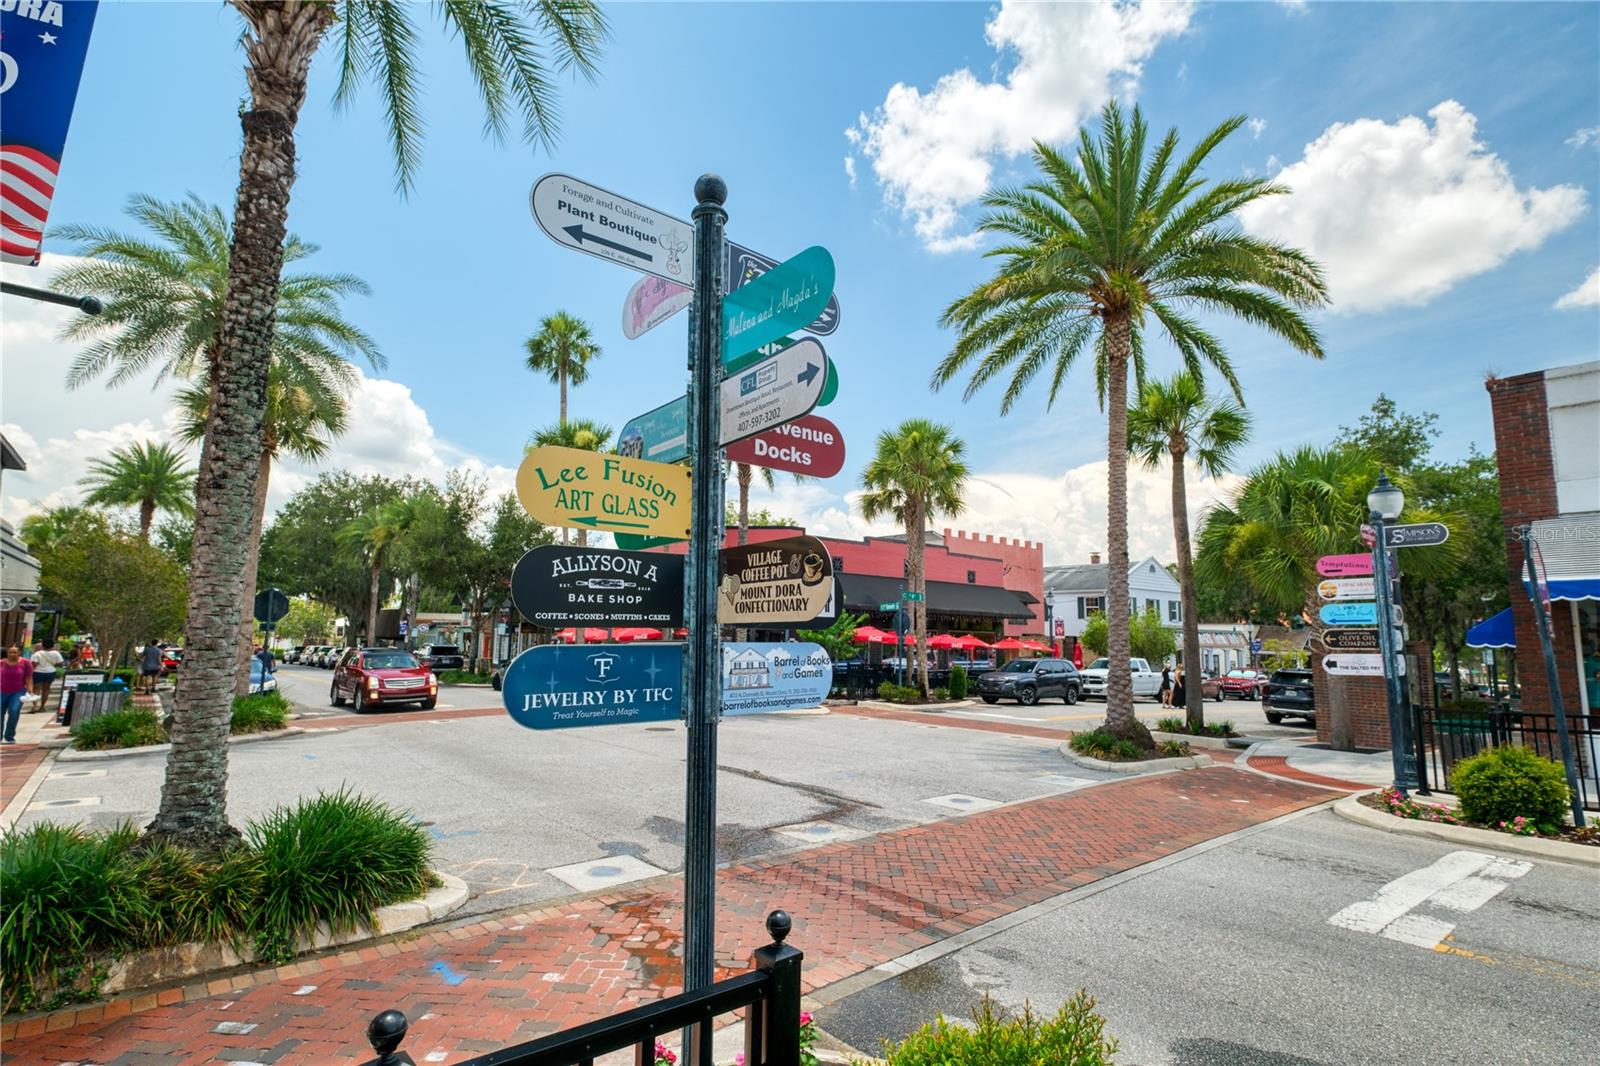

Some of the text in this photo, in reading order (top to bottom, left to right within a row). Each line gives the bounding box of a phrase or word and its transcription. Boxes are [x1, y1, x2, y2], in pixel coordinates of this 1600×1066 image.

[562, 184, 655, 226] Forage and Cultivate
[557, 199, 657, 245] Plant Boutique
[758, 295, 774, 318] and
[776, 274, 819, 313] Magda's
[741, 377, 755, 391] CFL
[737, 407, 781, 432] 407-597-3202
[754, 438, 812, 465] Docks
[535, 459, 677, 507] Lee Fusion
[555, 488, 660, 519] ART GLASS
[746, 549, 783, 567] VILLAGE
[1320, 560, 1369, 569] Temptations
[552, 555, 658, 583] ALLYSON A
[741, 566, 769, 582] COFFEE
[770, 564, 789, 579] POT
[568, 593, 643, 604] BAKE SHOP
[740, 583, 802, 600] MOUNT DORA
[734, 597, 810, 614] CONFECTIONARY
[535, 612, 568, 620] COFFEE
[574, 613, 604, 621] SCONES
[774, 656, 800, 667] Barrel
[807, 655, 830, 666] Books
[794, 668, 823, 679] Games
[522, 687, 673, 711] JEWELRY BY TFC
[723, 696, 821, 711] barrelofbooksandgames.com
[552, 711, 574, 720] Treat
[576, 708, 607, 719] Yourself
[616, 707, 640, 717] Magic
